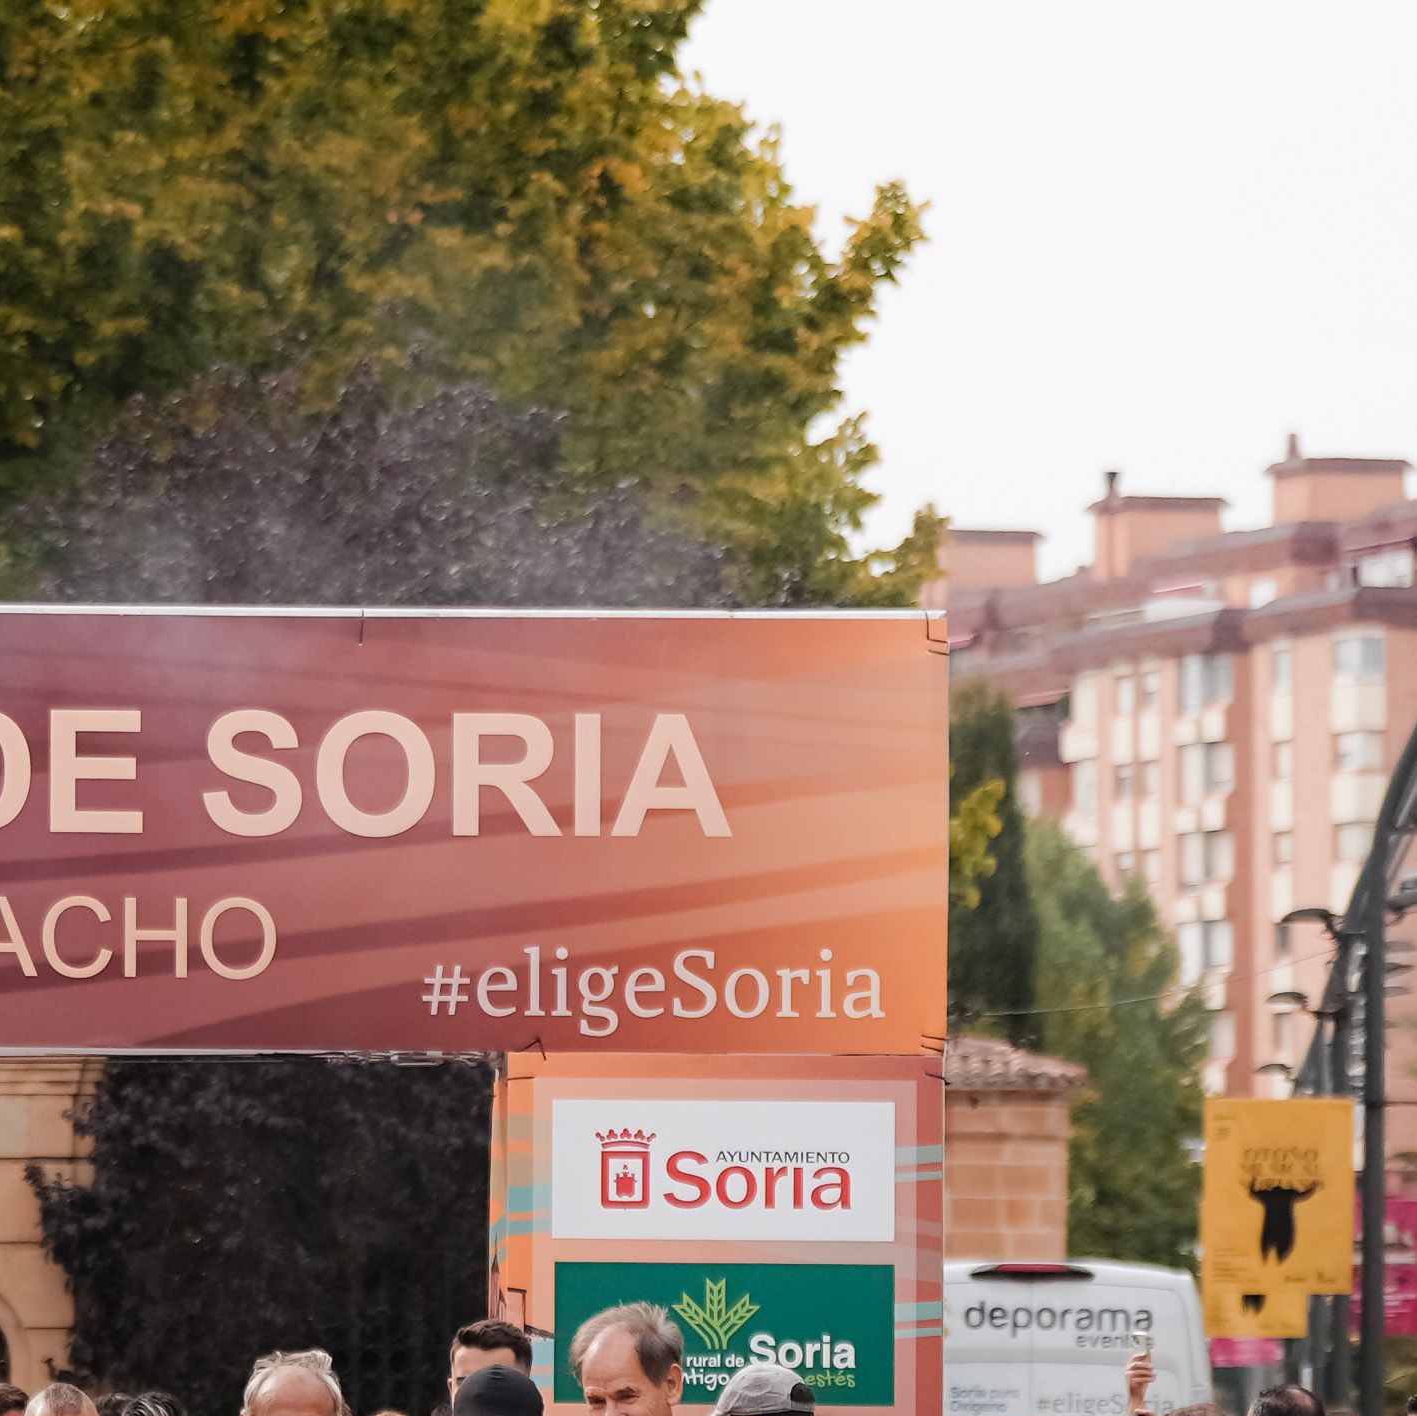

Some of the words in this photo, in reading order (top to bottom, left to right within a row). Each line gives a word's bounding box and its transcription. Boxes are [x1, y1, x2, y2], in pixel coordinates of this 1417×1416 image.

[203, 709, 733, 838] SORIA
[421, 945, 886, 1038] #eligeSoria
[716, 1151, 850, 1165] AYUNTAMIENTO
[663, 1151, 852, 1211] Soria
[964, 1300, 1154, 1338] deporama
[686, 1354, 721, 1368] rural
[725, 1354, 744, 1368] de
[748, 1334, 856, 1370] Soria
[682, 1367, 729, 1391] ntigo
